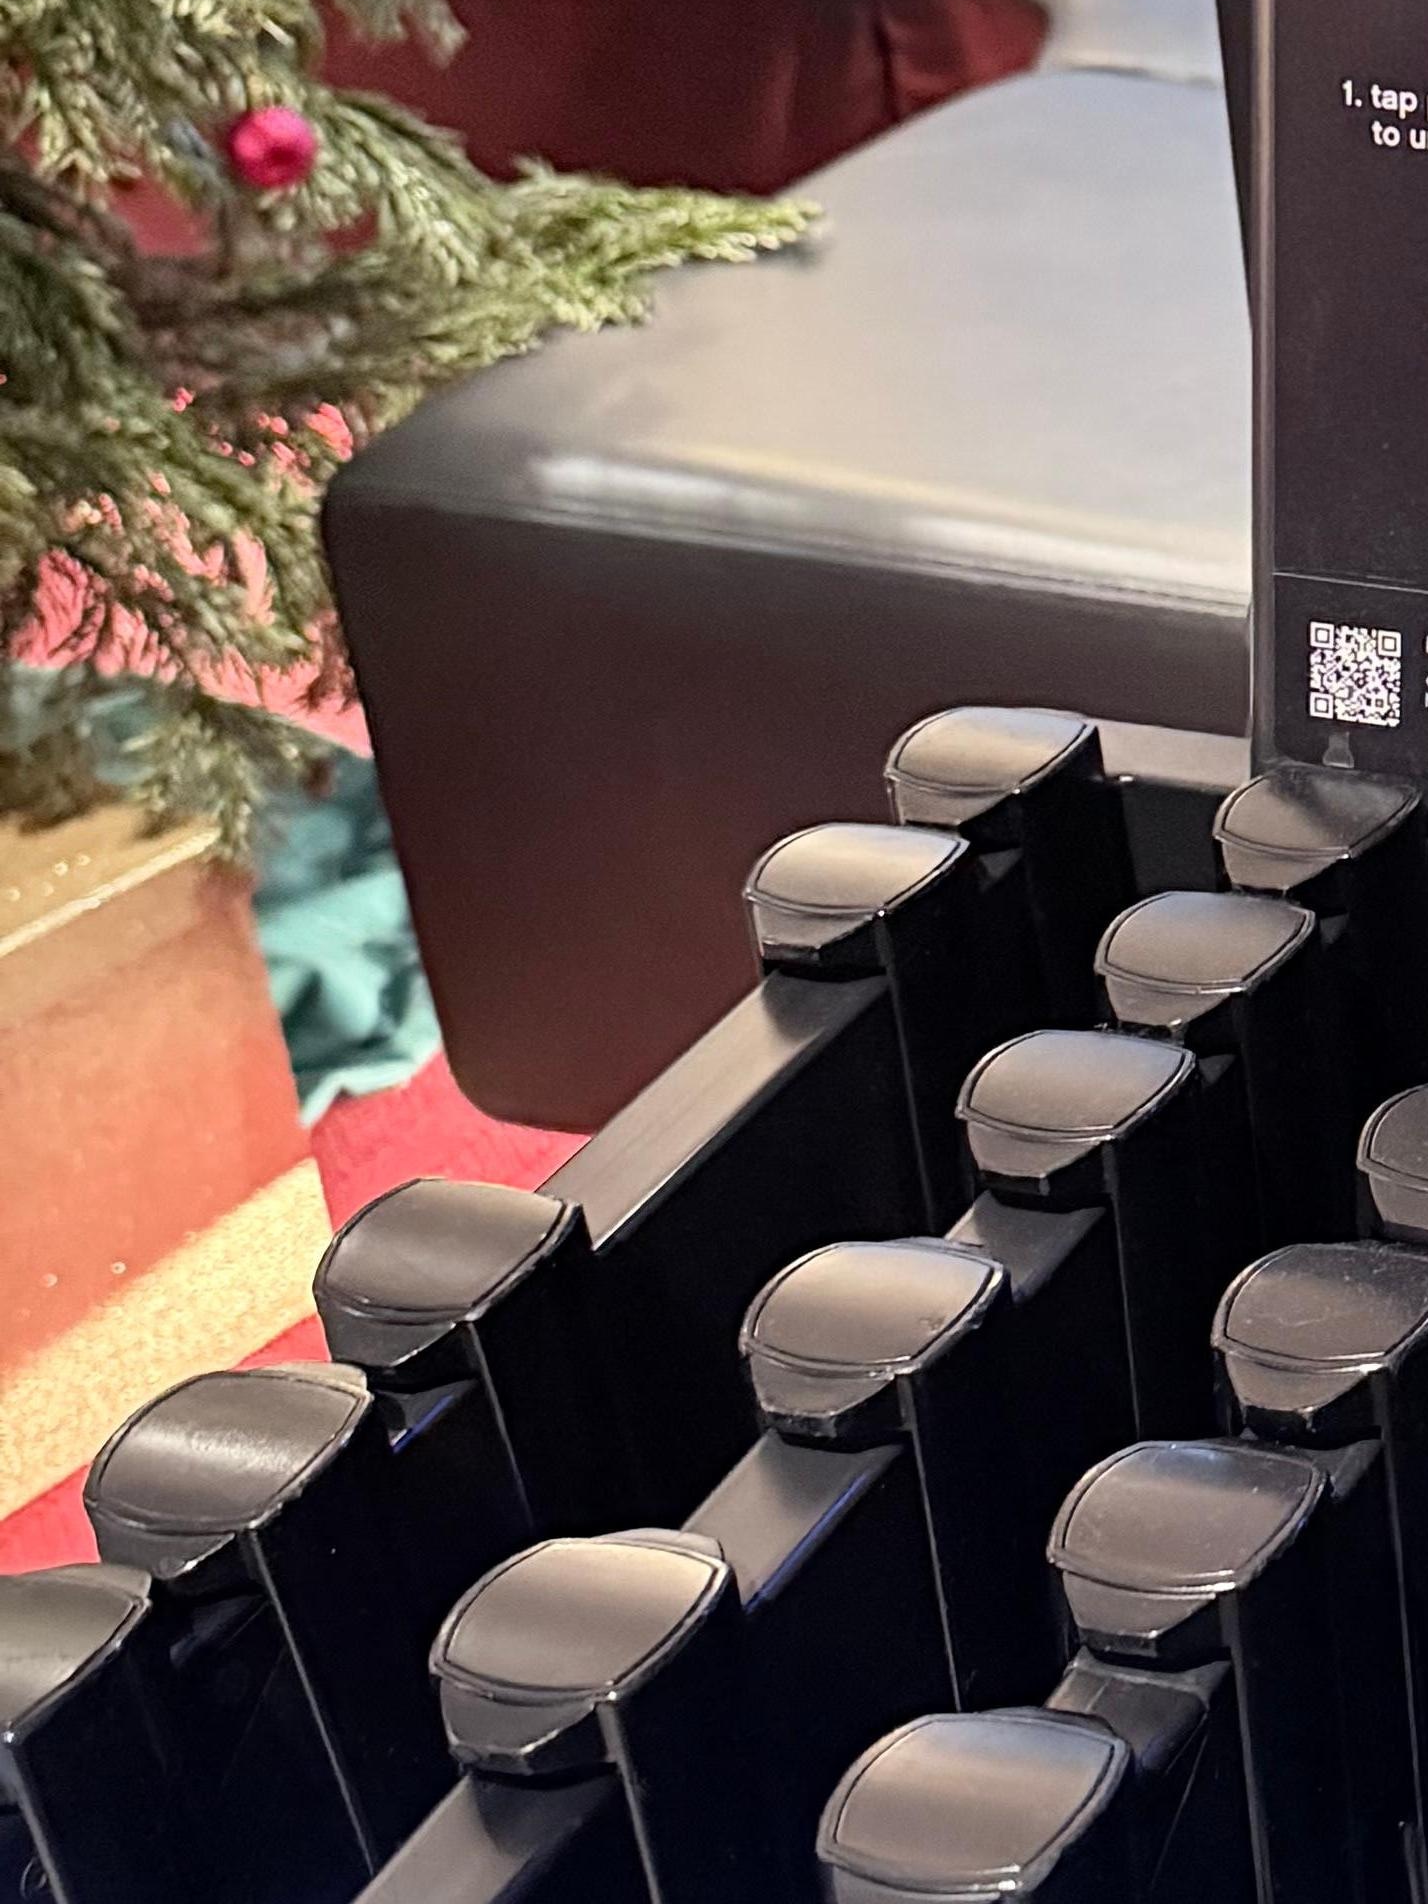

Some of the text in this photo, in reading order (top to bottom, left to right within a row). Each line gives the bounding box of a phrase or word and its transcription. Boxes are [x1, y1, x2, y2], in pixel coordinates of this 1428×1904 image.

[1342, 79, 1363, 108] 1.
[1370, 84, 1418, 120] tap
[1371, 120, 1401, 147] to
